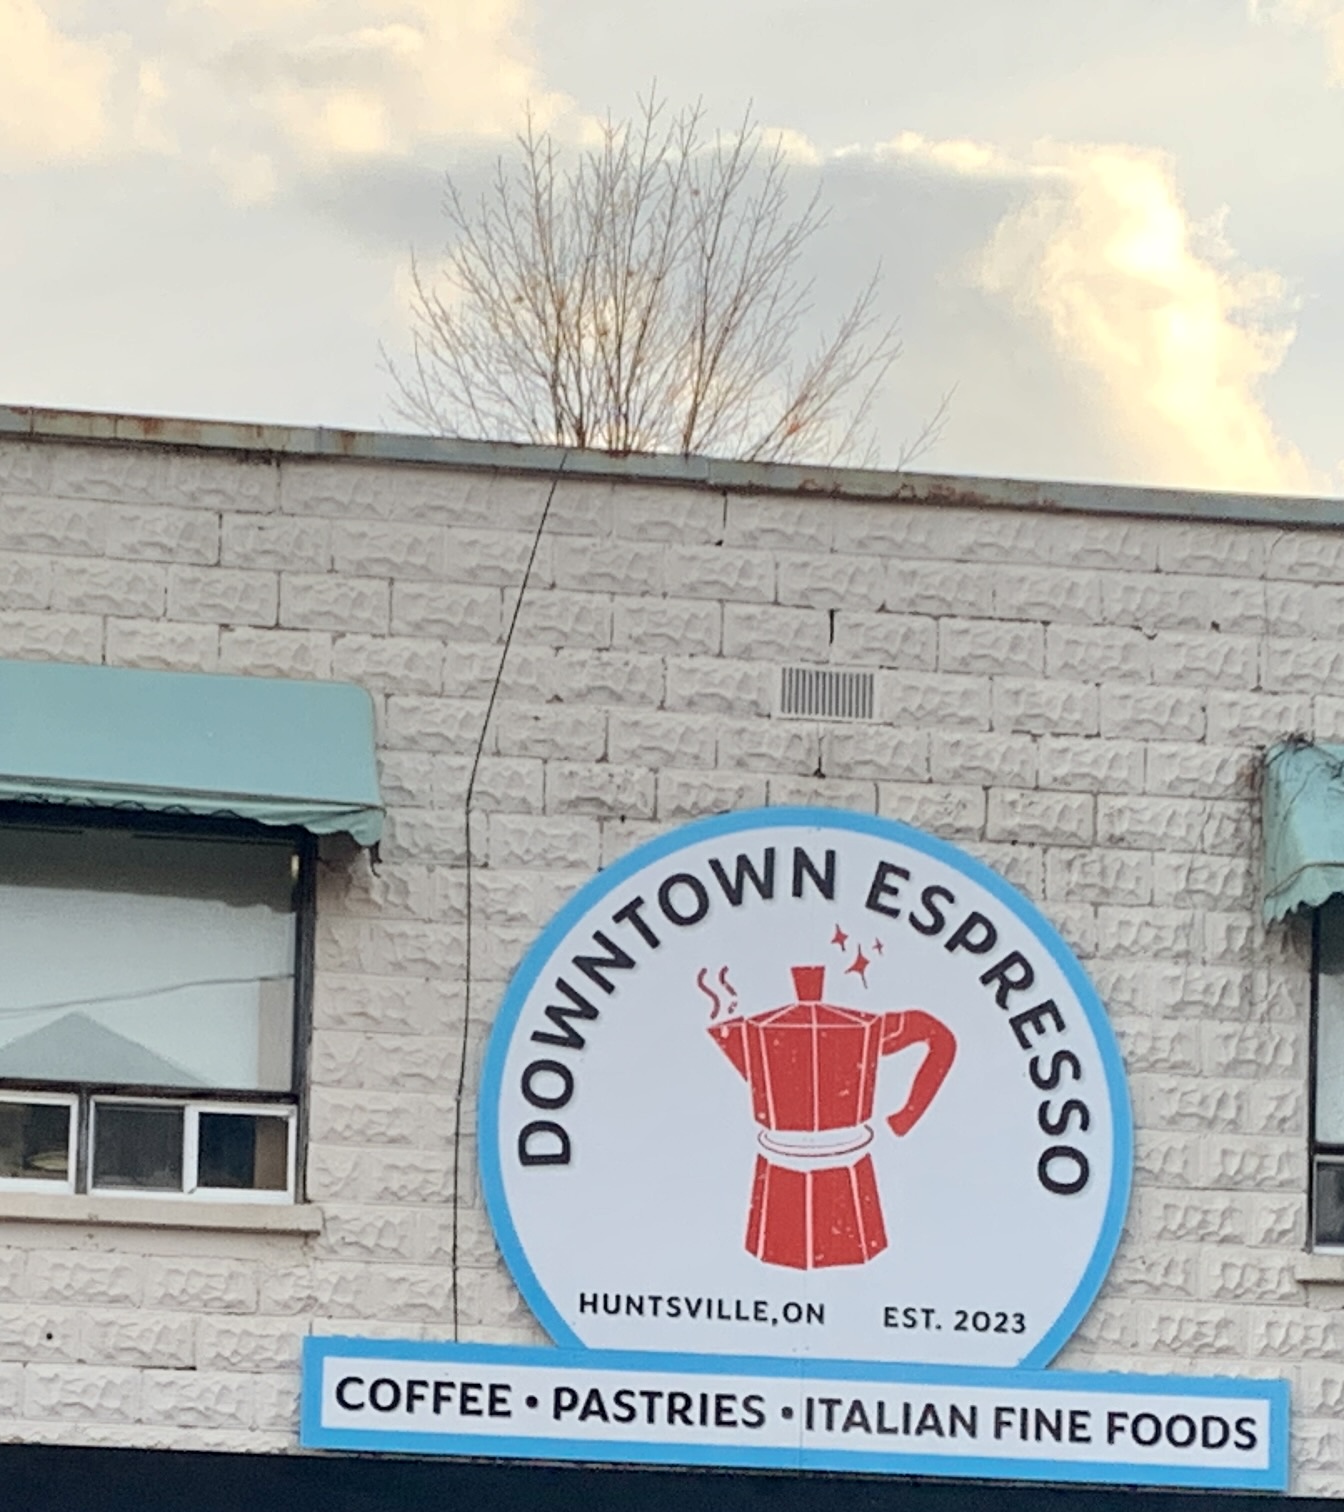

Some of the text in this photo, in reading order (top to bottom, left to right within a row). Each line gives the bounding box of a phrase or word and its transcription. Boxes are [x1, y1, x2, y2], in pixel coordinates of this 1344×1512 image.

[518, 846, 1090, 1196] DOWNTOWN ESPRESSO
[578, 1292, 827, 1326] HUNTSVILLE,ON
[883, 1305, 1027, 1335] EST. 2023
[334, 1375, 1258, 1451] COFFEE PASTRIES ITALIAN FINE FOODS
